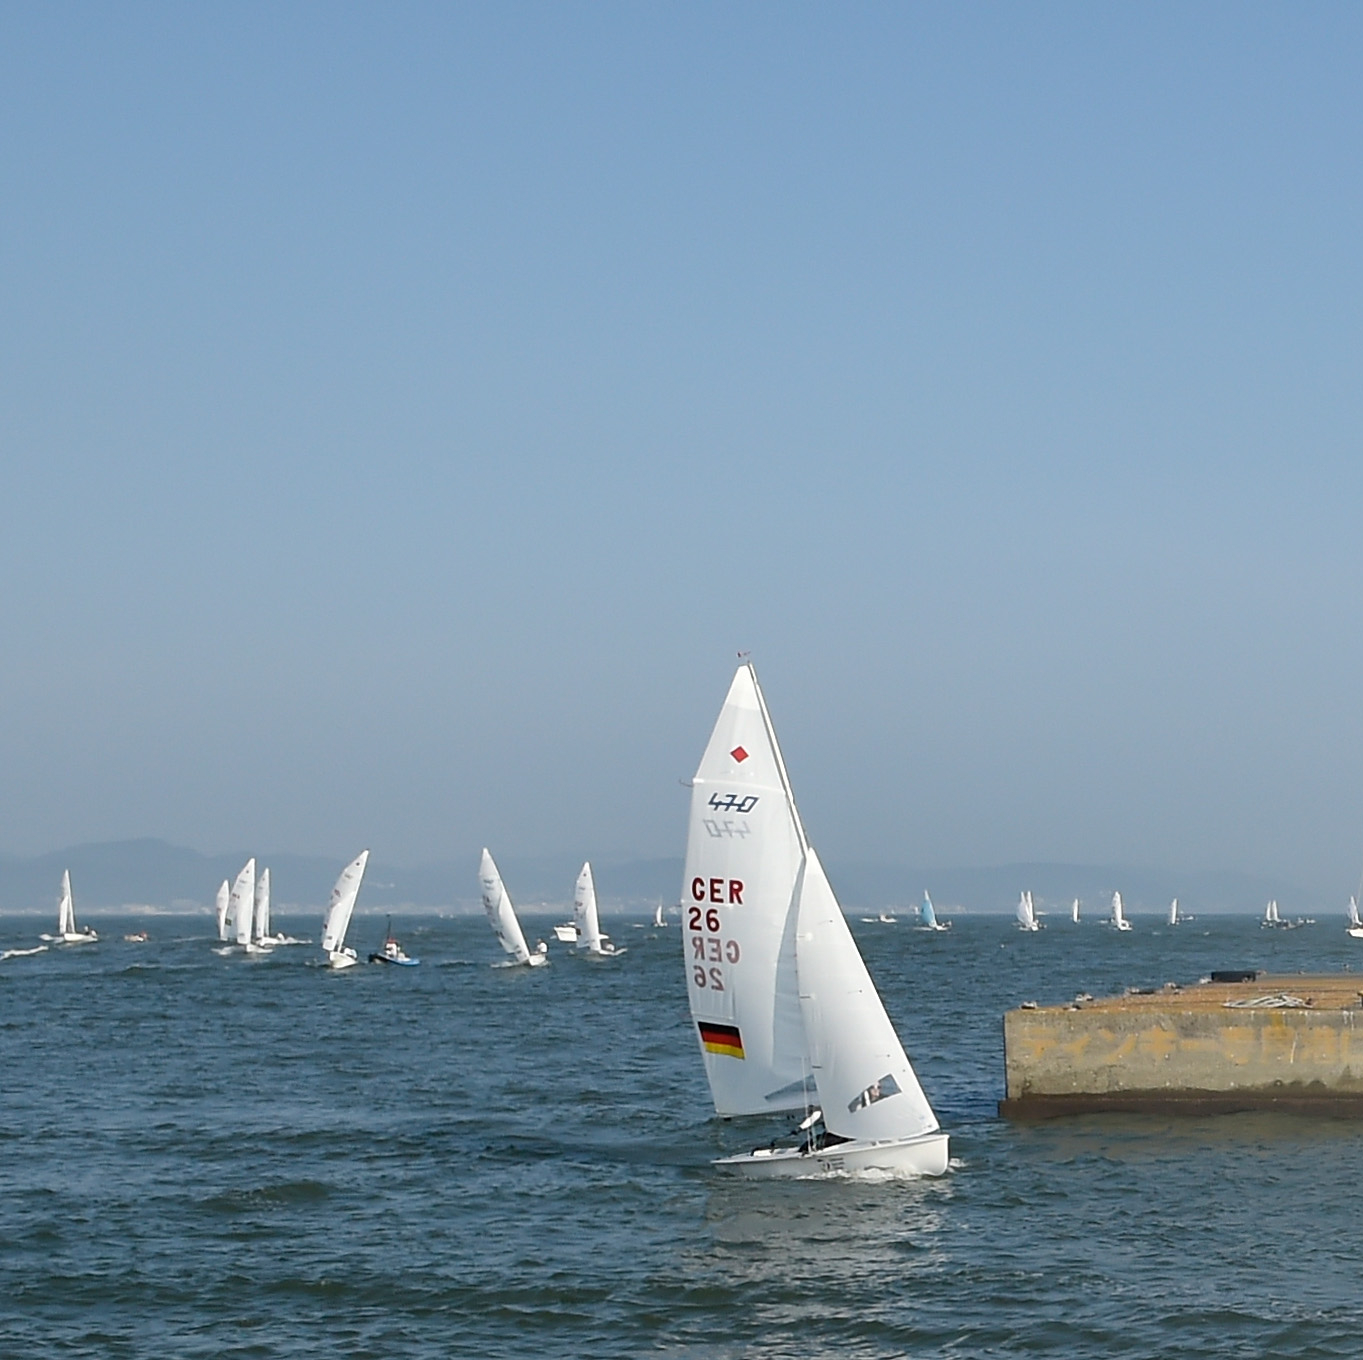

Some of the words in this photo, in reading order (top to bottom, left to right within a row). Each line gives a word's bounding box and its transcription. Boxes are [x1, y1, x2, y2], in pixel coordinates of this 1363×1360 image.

[708, 792, 760, 813] 470
[691, 877, 744, 904] GER
[688, 906, 720, 932] 26
